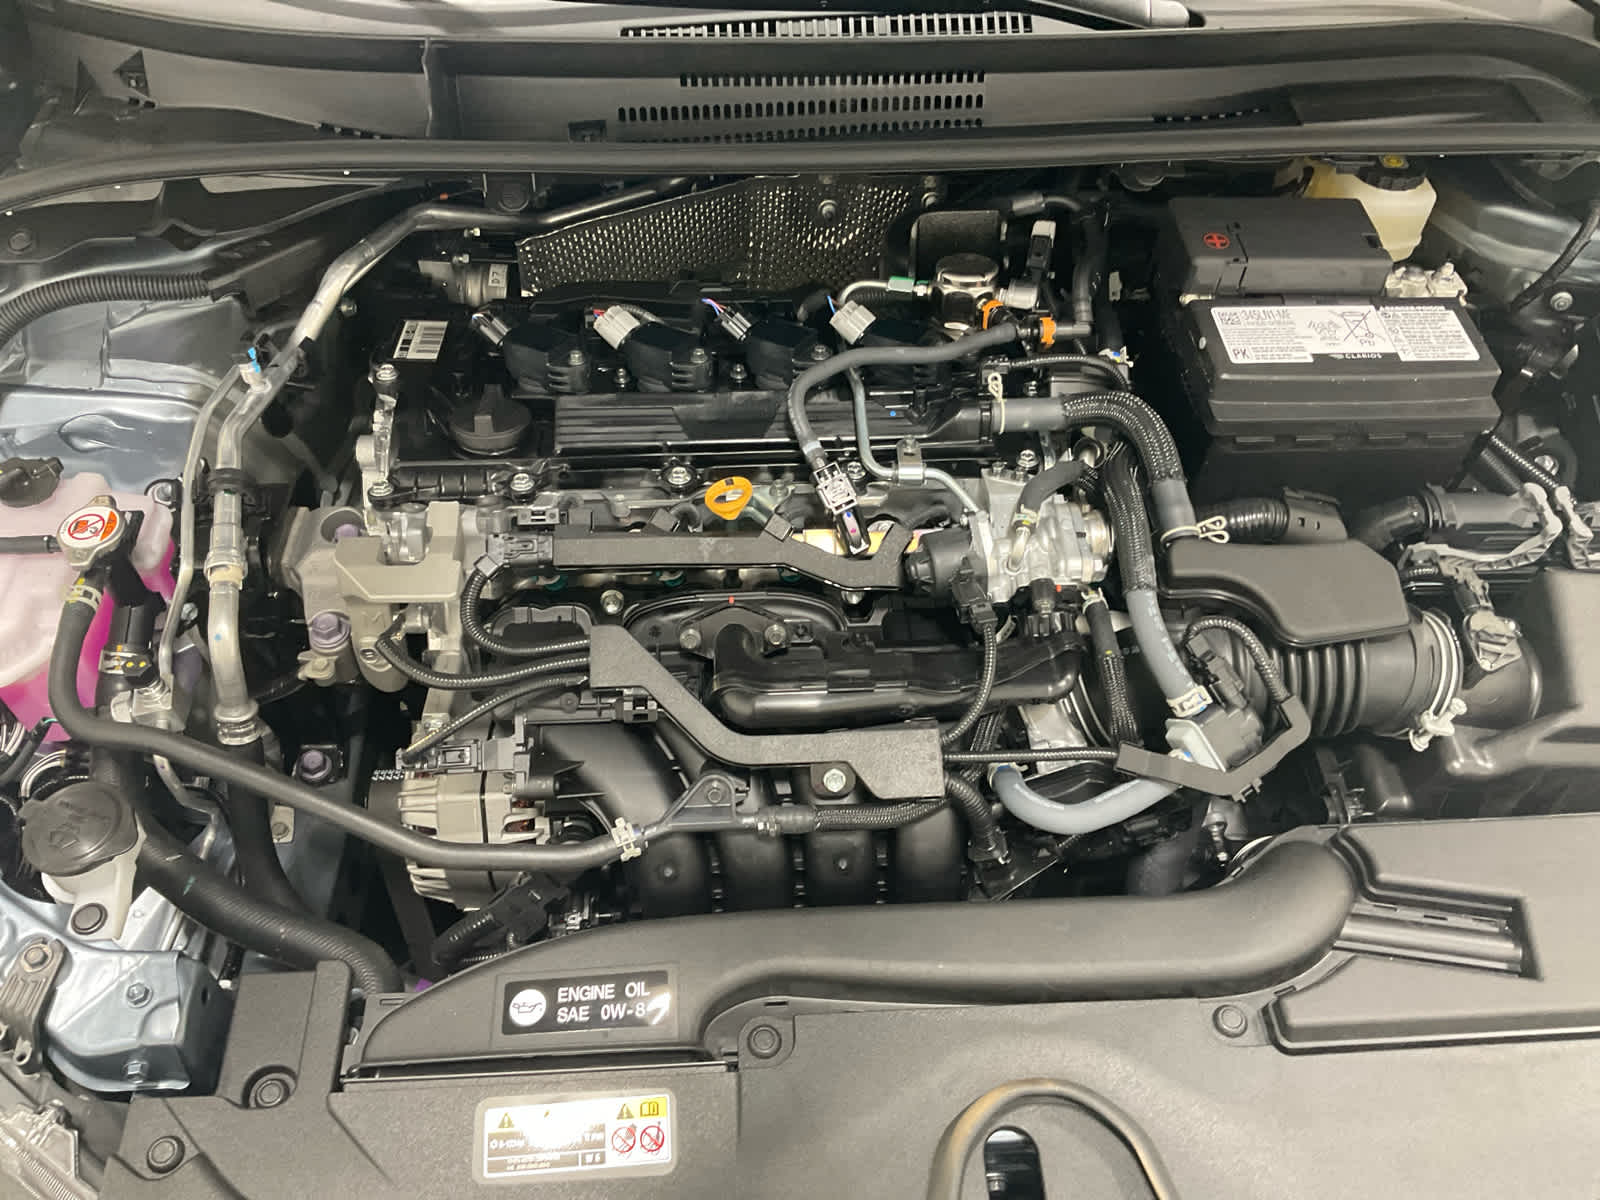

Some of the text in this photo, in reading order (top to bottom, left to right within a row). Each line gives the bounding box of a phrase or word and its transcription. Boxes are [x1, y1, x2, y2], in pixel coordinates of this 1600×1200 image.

[557, 981, 650, 1003] ENGINE OIL
[556, 1003, 646, 1024] SAE 0W-8
